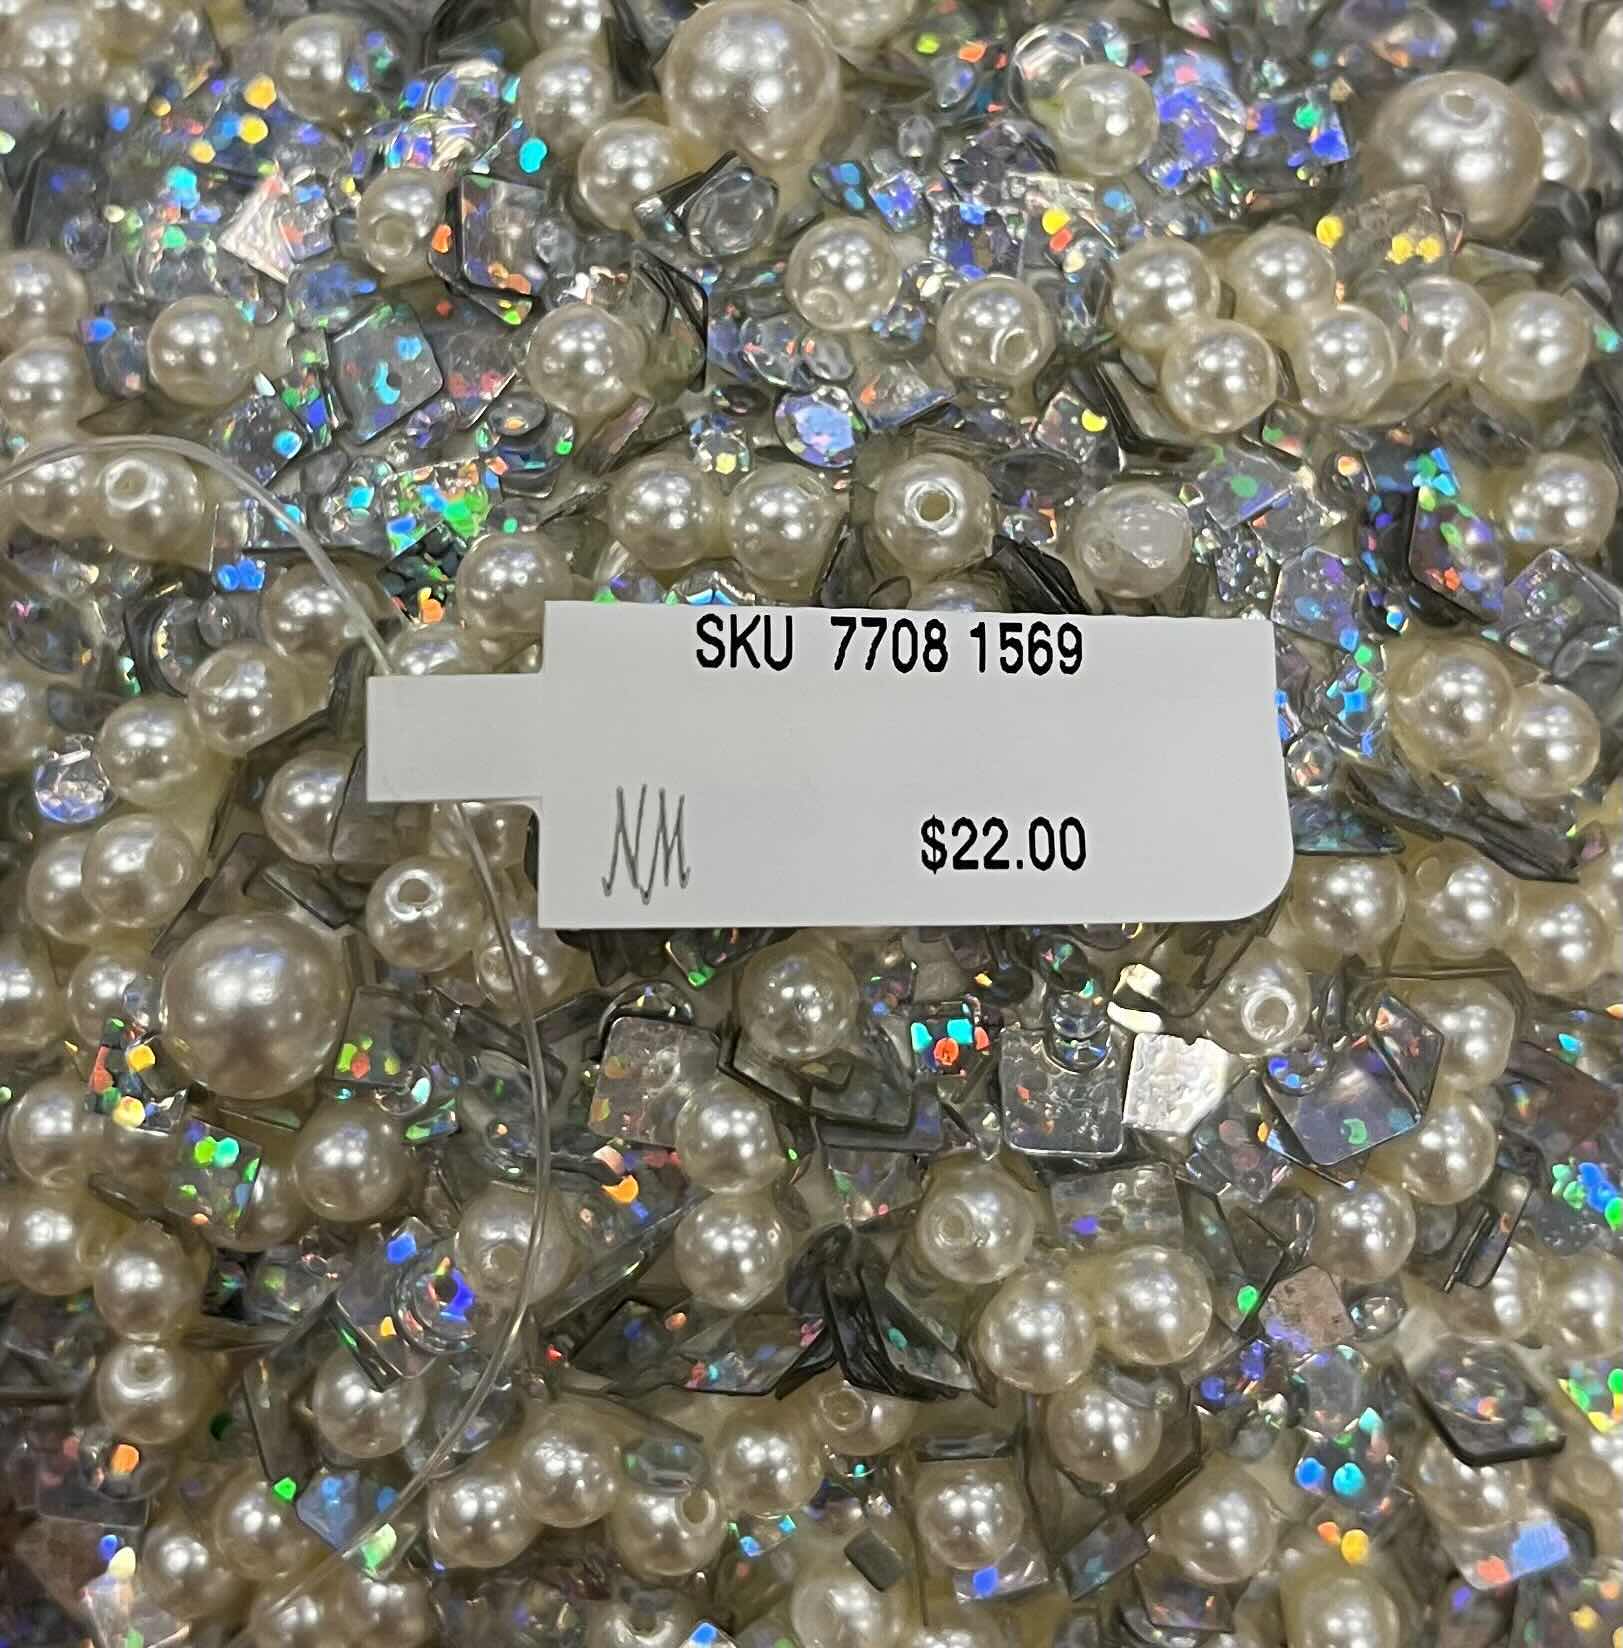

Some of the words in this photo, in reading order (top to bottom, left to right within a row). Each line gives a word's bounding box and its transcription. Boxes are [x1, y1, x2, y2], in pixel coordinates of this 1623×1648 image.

[695, 613, 793, 671] SKU
[830, 615, 949, 674] 7708
[968, 620, 1084, 676] 1569
[919, 814, 1088, 874] $22.00
